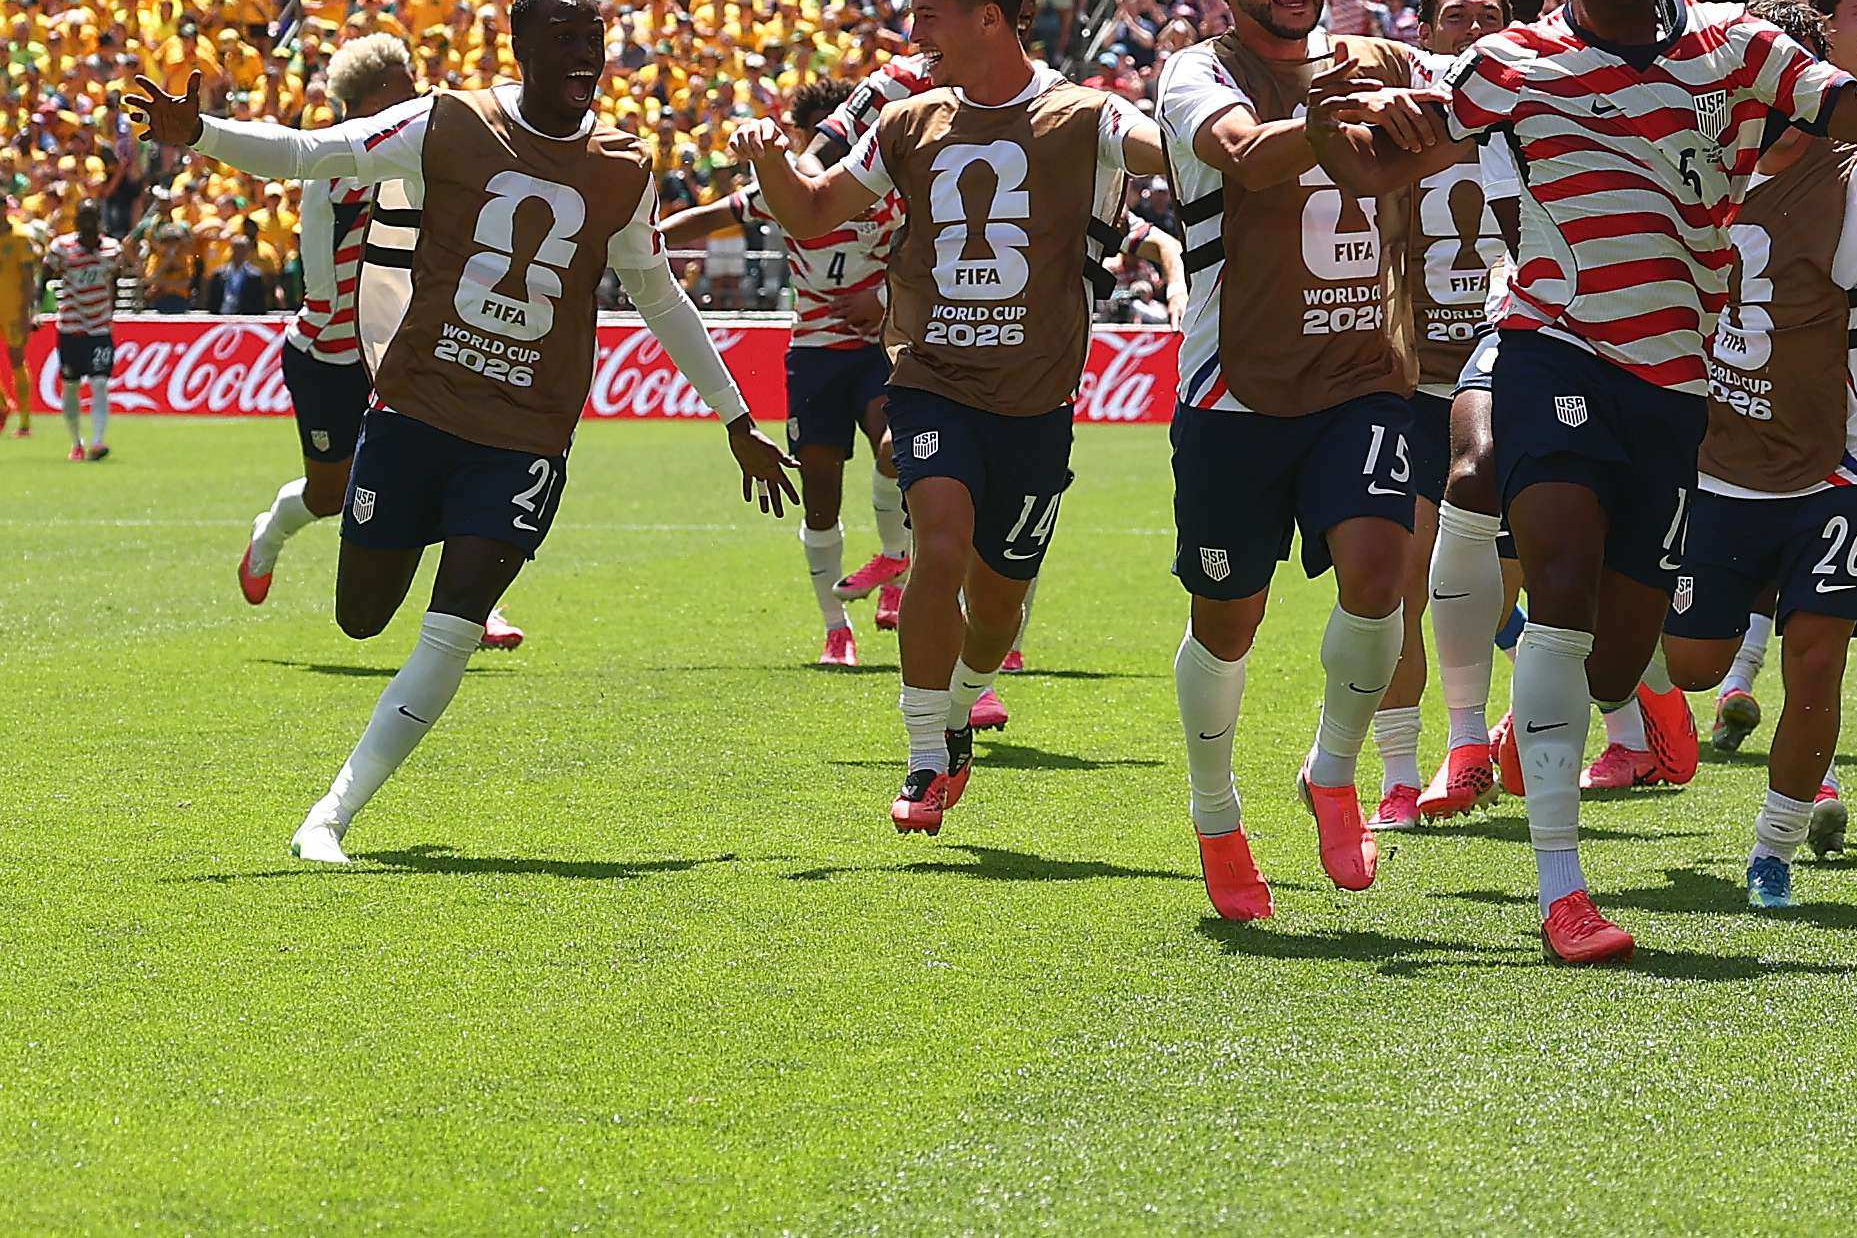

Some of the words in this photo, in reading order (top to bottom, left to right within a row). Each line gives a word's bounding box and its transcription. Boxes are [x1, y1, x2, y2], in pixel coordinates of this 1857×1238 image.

[1695, 92, 1724, 114] USA
[1335, 241, 1374, 263] FIFA
[827, 251, 846, 286] 4
[955, 268, 1001, 285] FIFA
[1303, 287, 1370, 306] WORLD
[481, 299, 527, 327] FIFA
[932, 304, 990, 321] WORLD
[992, 306, 1028, 321] CUP
[1425, 309, 1484, 320] WORLD
[442, 323, 505, 355] WORLD
[506, 346, 541, 364] CUP
[925, 322, 1025, 347] 2026
[1427, 322, 1474, 342] 20
[1721, 331, 1747, 355] FIFA
[39, 323, 297, 412] ca-Cola
[434, 339, 534, 387] 2026
[1710, 364, 1741, 386] ORLD
[1741, 377, 1773, 394] CUP
[1557, 397, 1583, 410] USA
[1708, 379, 1772, 420] 026
[914, 432, 937, 445] USA
[1363, 424, 1410, 483] 15
[356, 488, 375, 506] USA
[1005, 493, 1060, 547] 14
[1202, 548, 1226, 562] USA
